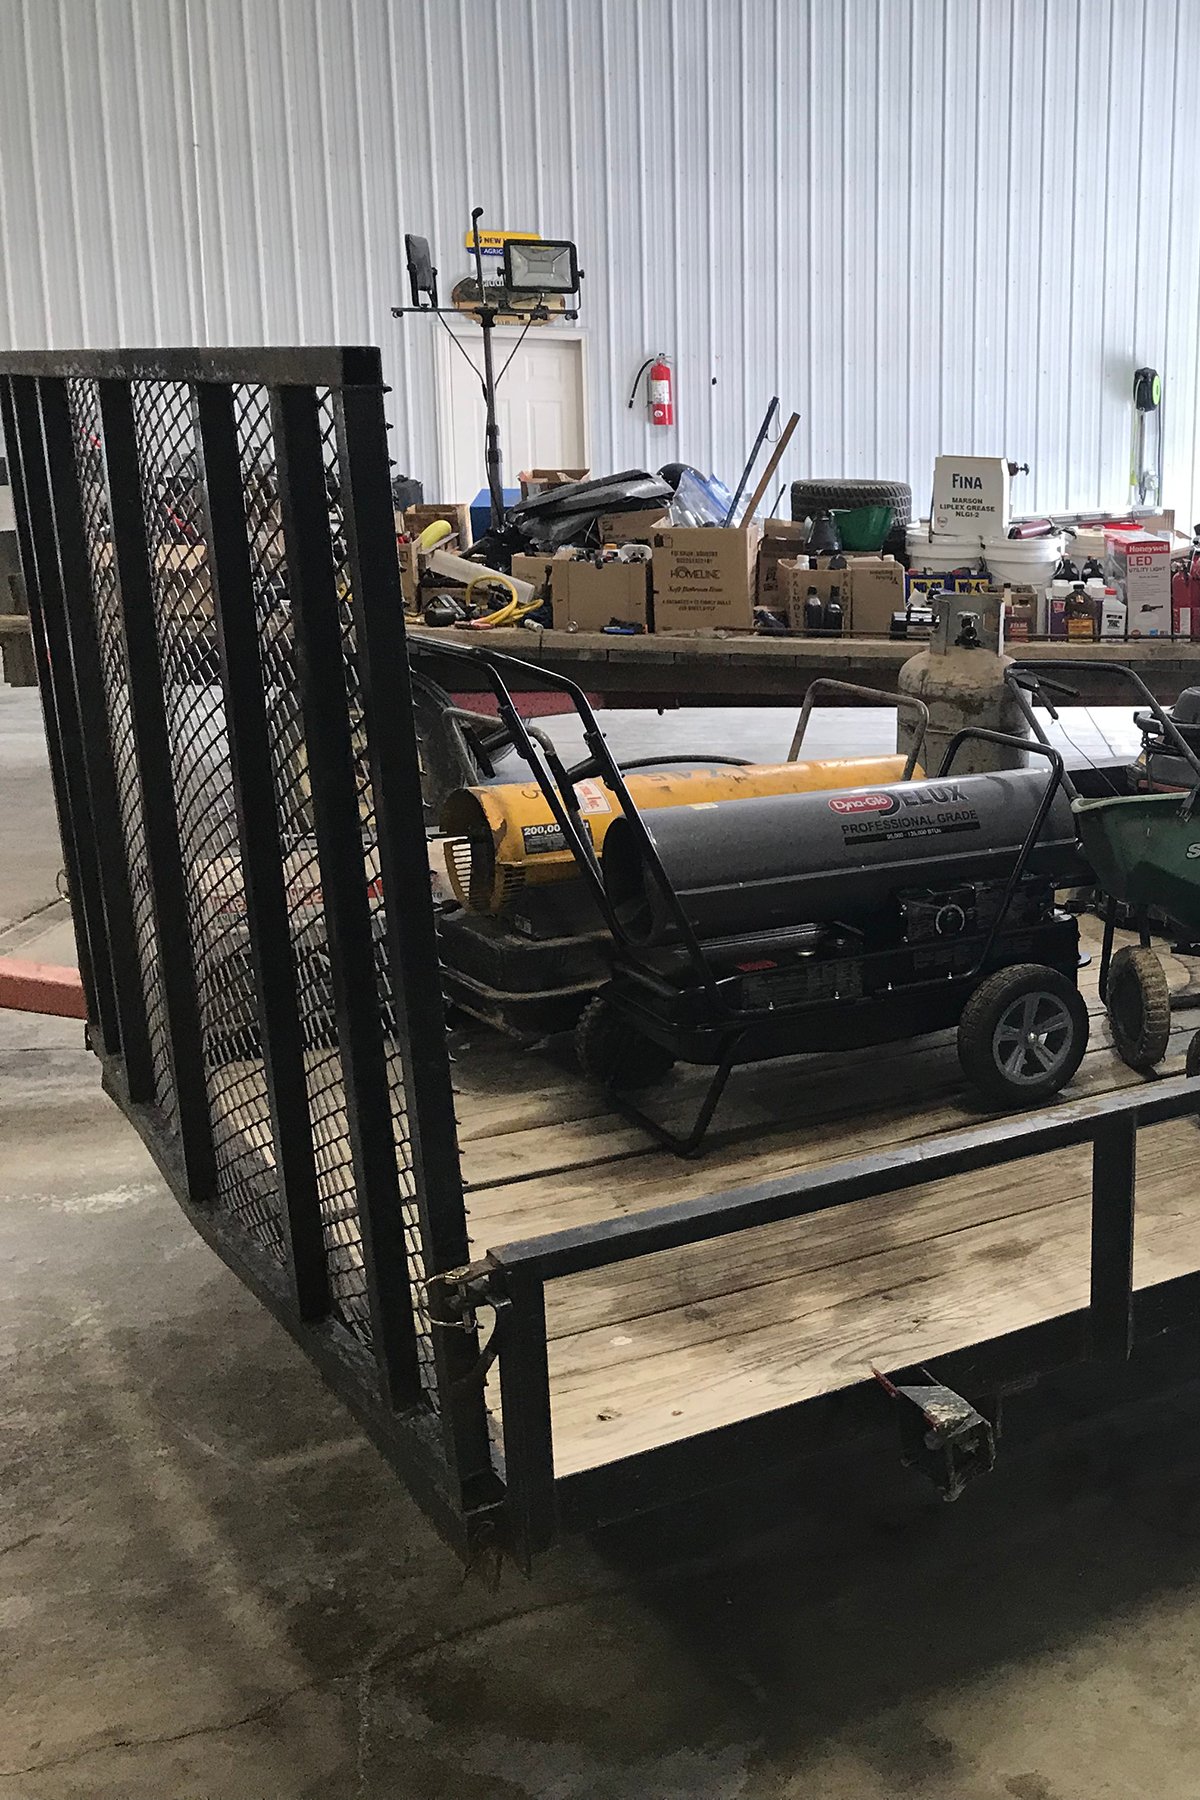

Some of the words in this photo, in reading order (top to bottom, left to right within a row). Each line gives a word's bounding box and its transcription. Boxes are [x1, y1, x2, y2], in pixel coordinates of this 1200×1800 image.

[952, 473, 983, 490] FINA
[1129, 544, 1169, 553] Honeywell
[1129, 556, 1152, 566] LED
[670, 566, 721, 579] HOMELINE
[834, 795, 888, 811] Dyna-Glo
[841, 817, 936, 834] PROFESSIONAL
[938, 810, 978, 823] GRADE
[524, 825, 561, 835] 200,00
